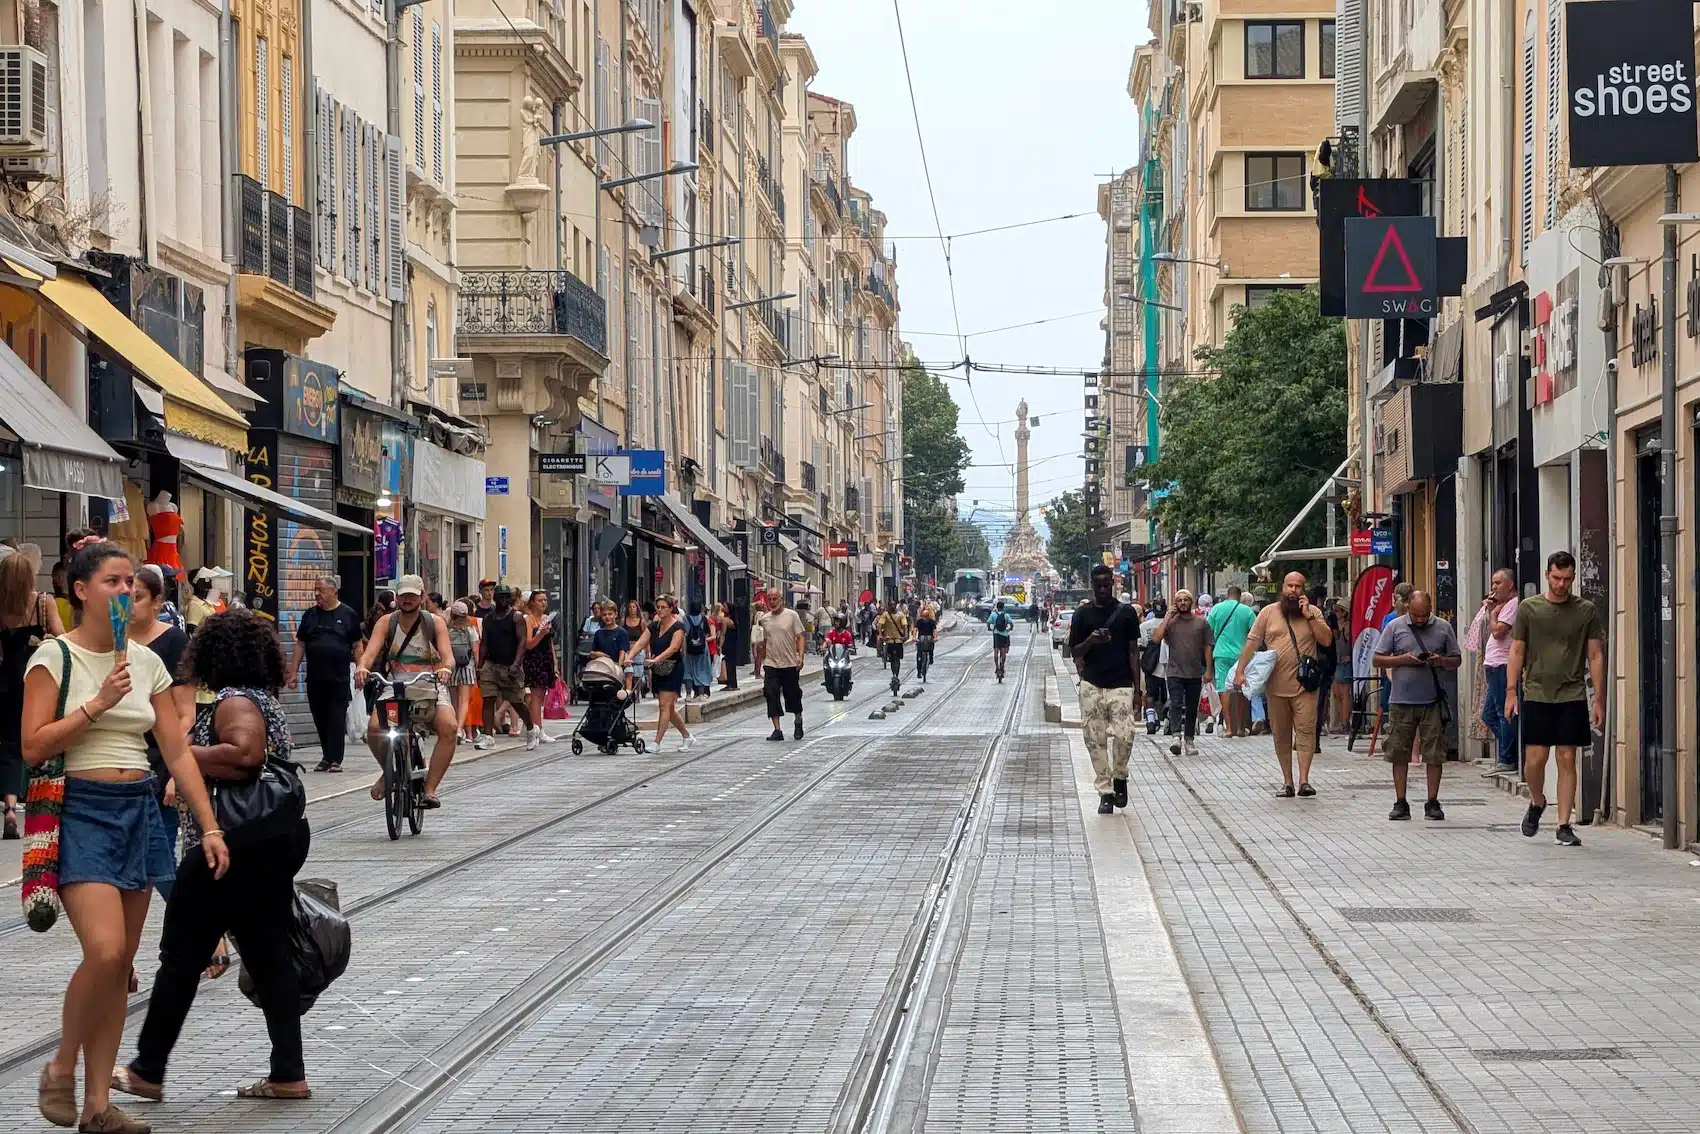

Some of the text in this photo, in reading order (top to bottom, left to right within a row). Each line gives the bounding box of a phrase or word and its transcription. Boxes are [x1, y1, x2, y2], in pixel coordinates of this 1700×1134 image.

[1608, 60, 1687, 84] street
[1574, 74, 1692, 117] shoes
[248, 445, 269, 466] LA
[595, 456, 613, 474] K
[254, 582, 274, 597] DU
[1365, 577, 1389, 621] SYMA
